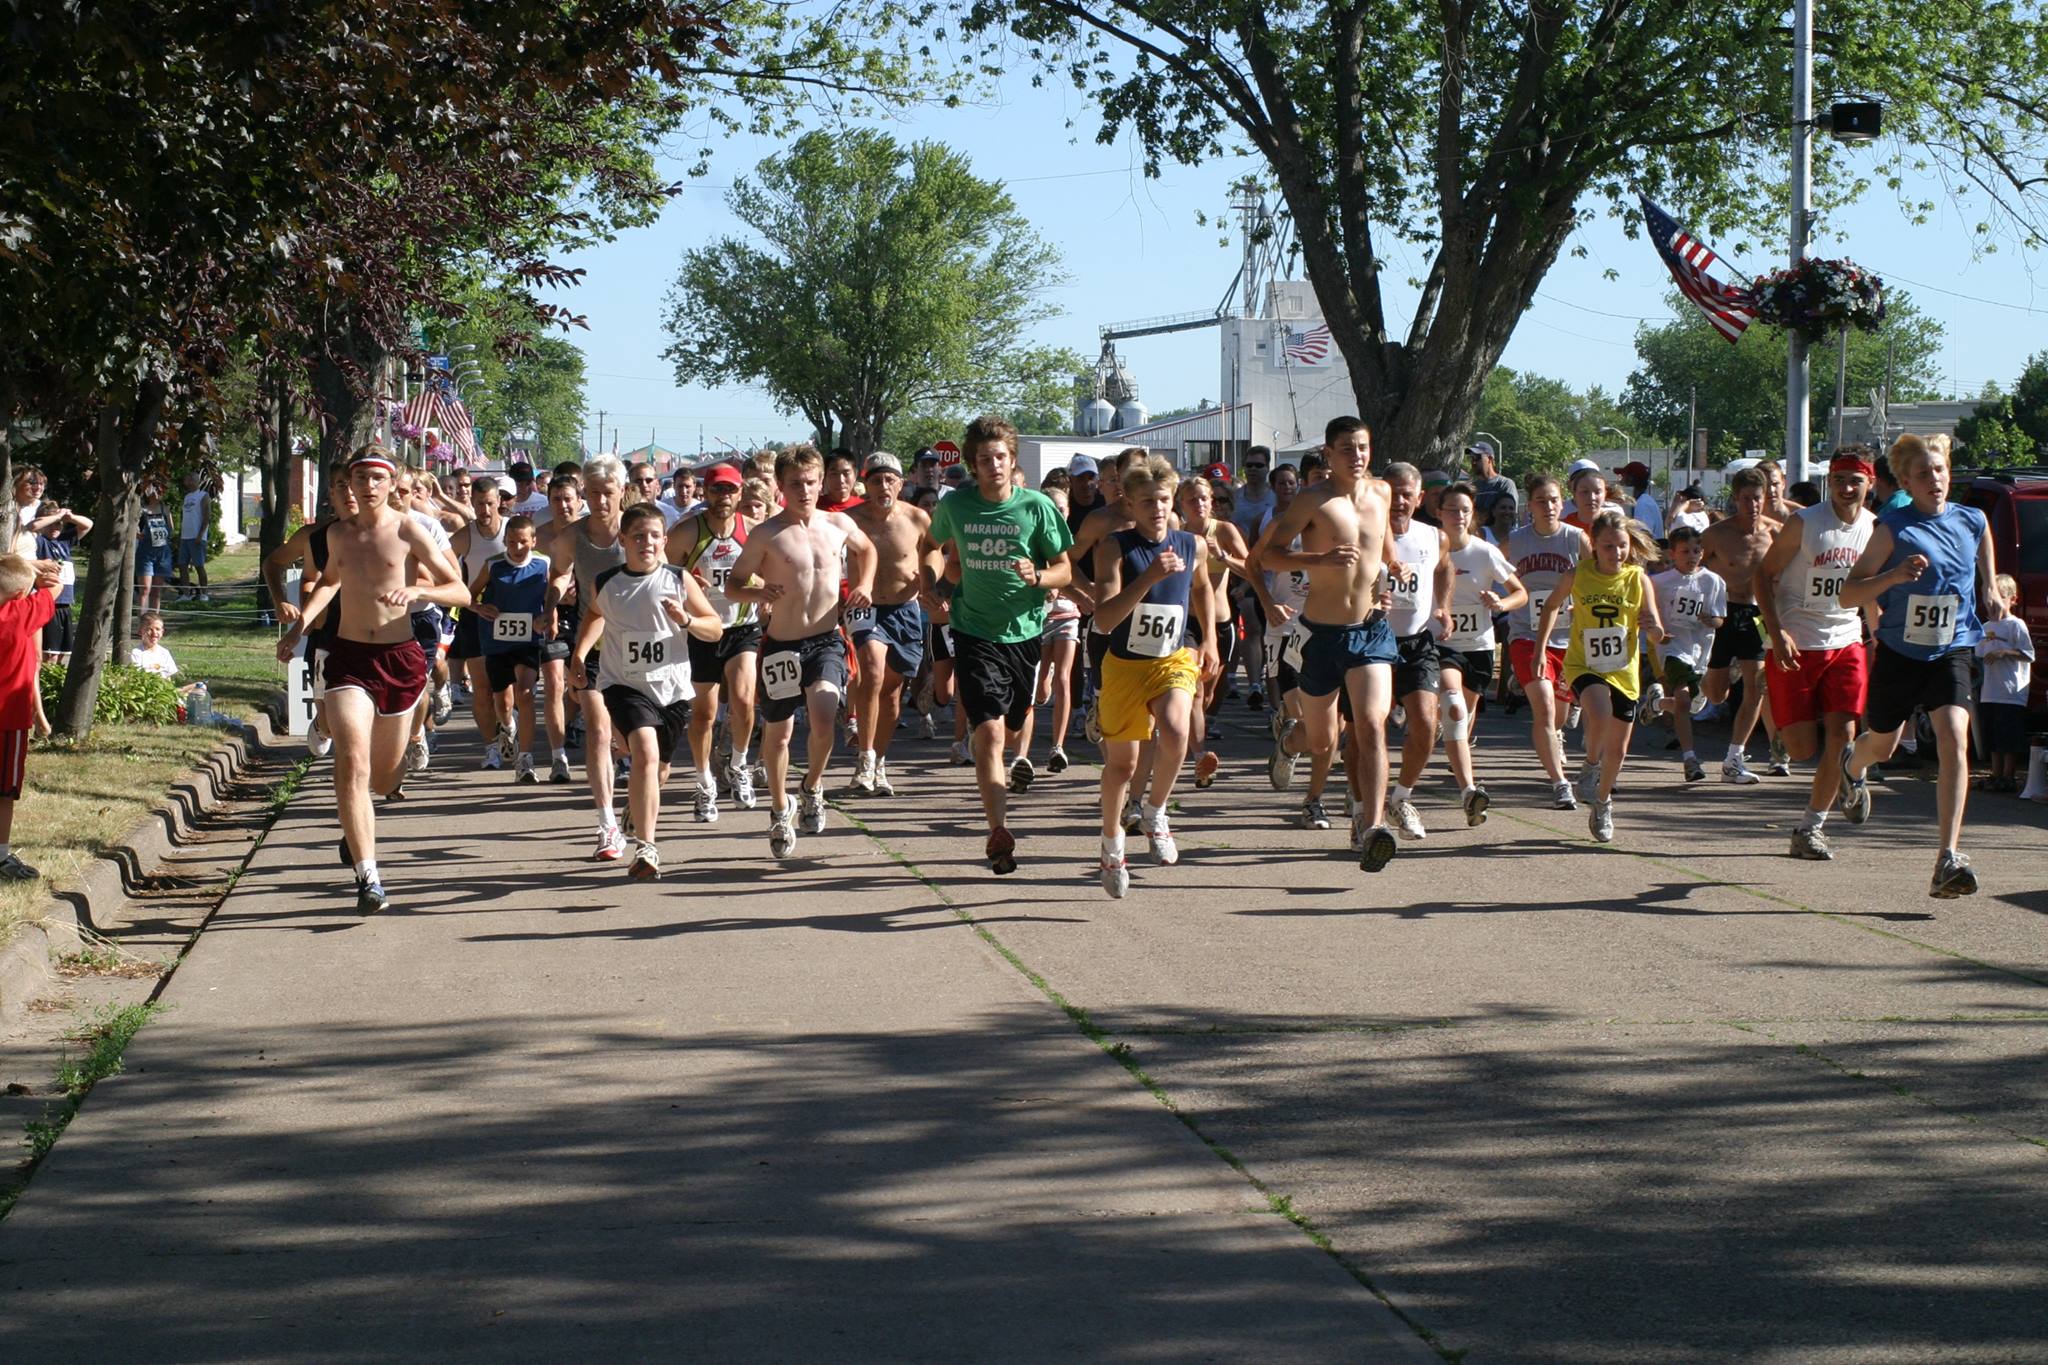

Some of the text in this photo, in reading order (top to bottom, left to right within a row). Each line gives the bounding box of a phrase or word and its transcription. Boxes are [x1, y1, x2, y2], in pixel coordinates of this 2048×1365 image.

[938, 450, 959, 462] TOP
[964, 523, 1020, 536] MARAWOOD
[1677, 597, 1703, 617] 530
[1913, 605, 1949, 628] 591
[499, 620, 527, 637] 553
[1138, 614, 1176, 639] 564
[628, 641, 664, 664] 548
[1590, 636, 1622, 657] 563
[764, 660, 798, 685] 579
